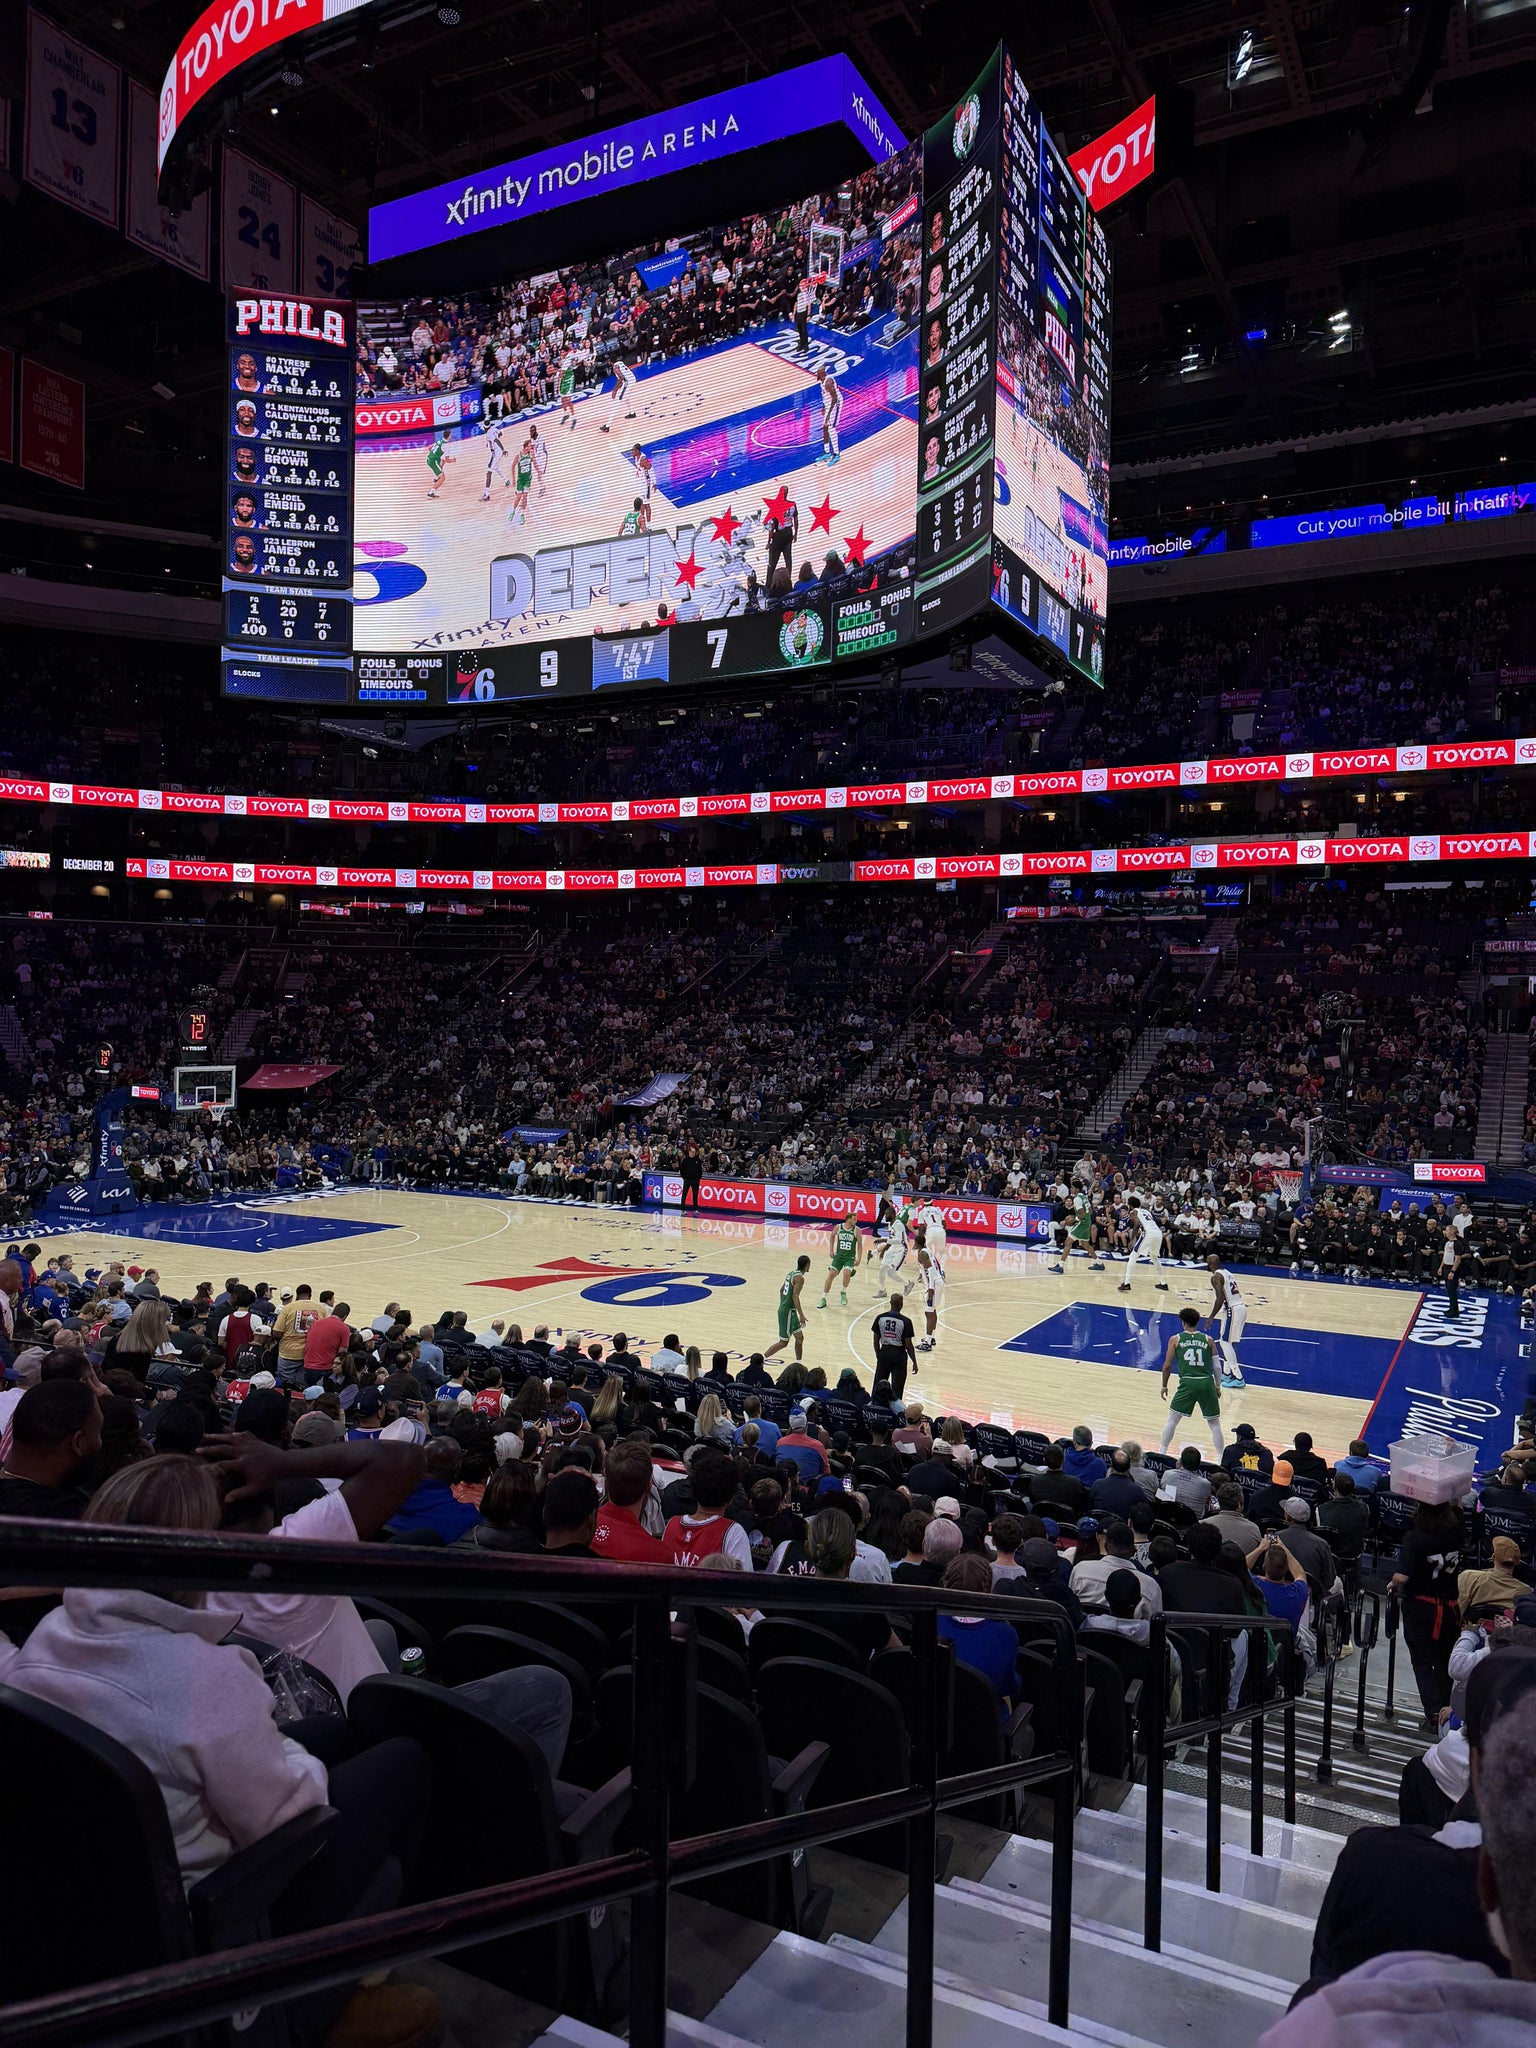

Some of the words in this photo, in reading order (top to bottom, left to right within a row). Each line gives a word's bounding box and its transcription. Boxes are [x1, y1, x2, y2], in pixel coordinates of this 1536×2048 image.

[51, 86, 97, 146] 13
[446, 173, 533, 225] xfinity
[538, 141, 635, 195] mobile
[641, 112, 740, 162] ARENA
[238, 205, 281, 261] 24
[236, 299, 347, 347] PHILA
[1044, 310, 1076, 387] PHILA
[278, 357, 310, 368] TYRESE
[266, 363, 306, 377] MAXEY
[271, 375, 279, 385] 4
[290, 378, 298, 387] 0
[310, 380, 318, 389] 1
[329, 381, 337, 391] 0
[266, 384, 283, 393] PTS
[286, 386, 303, 395] REB
[306, 388, 322, 397] AST
[326, 390, 341, 398] FLS
[278, 404, 330, 416] KENTAVIOUS
[265, 410, 341, 425] CALDWELL-POPE
[944, 418, 965, 442] GRAY
[277, 448, 308, 458] JAYLEN
[264, 454, 309, 467] BROWN
[281, 493, 302, 502] JOEL
[264, 499, 306, 512] EMBIID
[953, 497, 965, 515] 33
[972, 511, 982, 529] 17
[1297, 520, 1324, 535] Cut
[1327, 513, 1364, 533] your
[1368, 505, 1423, 525] mobile
[1426, 501, 1451, 517] bill
[1454, 500, 1470, 512] in
[263, 544, 302, 557] JAMES
[281, 538, 315, 549] LEBRON
[1141, 536, 1193, 558] mobile
[264, 585, 287, 594] TEAM
[289, 587, 313, 596] STATS
[838, 600, 871, 618] FOULS
[880, 590, 912, 607] BONUS
[280, 607, 298, 618] 20
[319, 609, 328, 620] 7
[1021, 574, 1031, 617] 9
[1076, 622, 1085, 660] 7
[241, 623, 267, 636] 100
[480, 614, 573, 648] ARENA
[838, 621, 886, 644] TIMEOUTS
[257, 654, 281, 663] TEAM
[282, 656, 319, 666] LEADERS
[360, 658, 396, 669] FOULS
[407, 658, 443, 669] BONUS
[456, 668, 496, 701] 76
[540, 650, 559, 688] 9
[611, 641, 655, 668] 7:47
[706, 628, 728, 669] 7
[233, 669, 261, 678] BLOCKS
[359, 679, 414, 690] TIMEOUTS
[1432, 746, 1509, 764] TOYOTA
[1212, 761, 1279, 777] TOYOTA
[1320, 754, 1391, 771] TOYOTA
[1019, 776, 1078, 791] TOYOTA
[1112, 769, 1176, 784] TOYOTA
[78, 789, 135, 804] TOYOTA
[850, 787, 902, 802] TOYOTA
[932, 782, 987, 797] TOYOTA
[167, 795, 221, 809] TOYOTA
[251, 800, 304, 813] TOYOTA
[701, 798, 747, 811] TOYOTA
[773, 793, 822, 806] TOYOTA
[334, 804, 385, 817] TOYOTA
[412, 806, 463, 818] TOYOTA
[489, 807, 536, 819] TOYOTA
[561, 806, 609, 818] TOYOTA
[632, 803, 676, 815] TOYOTA
[1331, 842, 1403, 858] TOYOTA
[1445, 838, 1522, 854] TOYOTA
[1122, 850, 1185, 866] TOYOTA
[1223, 846, 1290, 861] TOYOTA
[63, 858, 102, 871] DECEMBER
[103, 859, 115, 872] 20
[940, 859, 995, 874] TOYOTA
[1028, 854, 1087, 869] TOYOTA
[174, 864, 229, 878] TOYOTA
[259, 868, 312, 881] TOYOTA
[342, 871, 392, 883] TOYOTA
[707, 869, 754, 881] TOYOTA
[858, 863, 910, 877] TOYOTA
[420, 873, 470, 885] TOYOTA
[496, 874, 542, 885] TOYOTA
[568, 873, 615, 885] TOYOTA
[638, 872, 683, 883] TOYOTA
[191, 1023, 204, 1040] 12
[139, 1088, 159, 1097] TOYOTA
[99, 1129, 110, 1168] xfinity
[1434, 1167, 1483, 1178] TOYOTA
[646, 1184, 661, 1199] 76
[1391, 1187, 1456, 1199] ticketmater
[796, 1193, 868, 1215] TOYOTA
[1028, 1216, 1049, 1236] 76
[839, 1240, 853, 1251] 26
[884, 1319, 898, 1332] 33
[1183, 1347, 1206, 1367] 41
[1379, 1496, 1404, 1511] NJM
[1484, 1513, 1509, 1528] NJM
